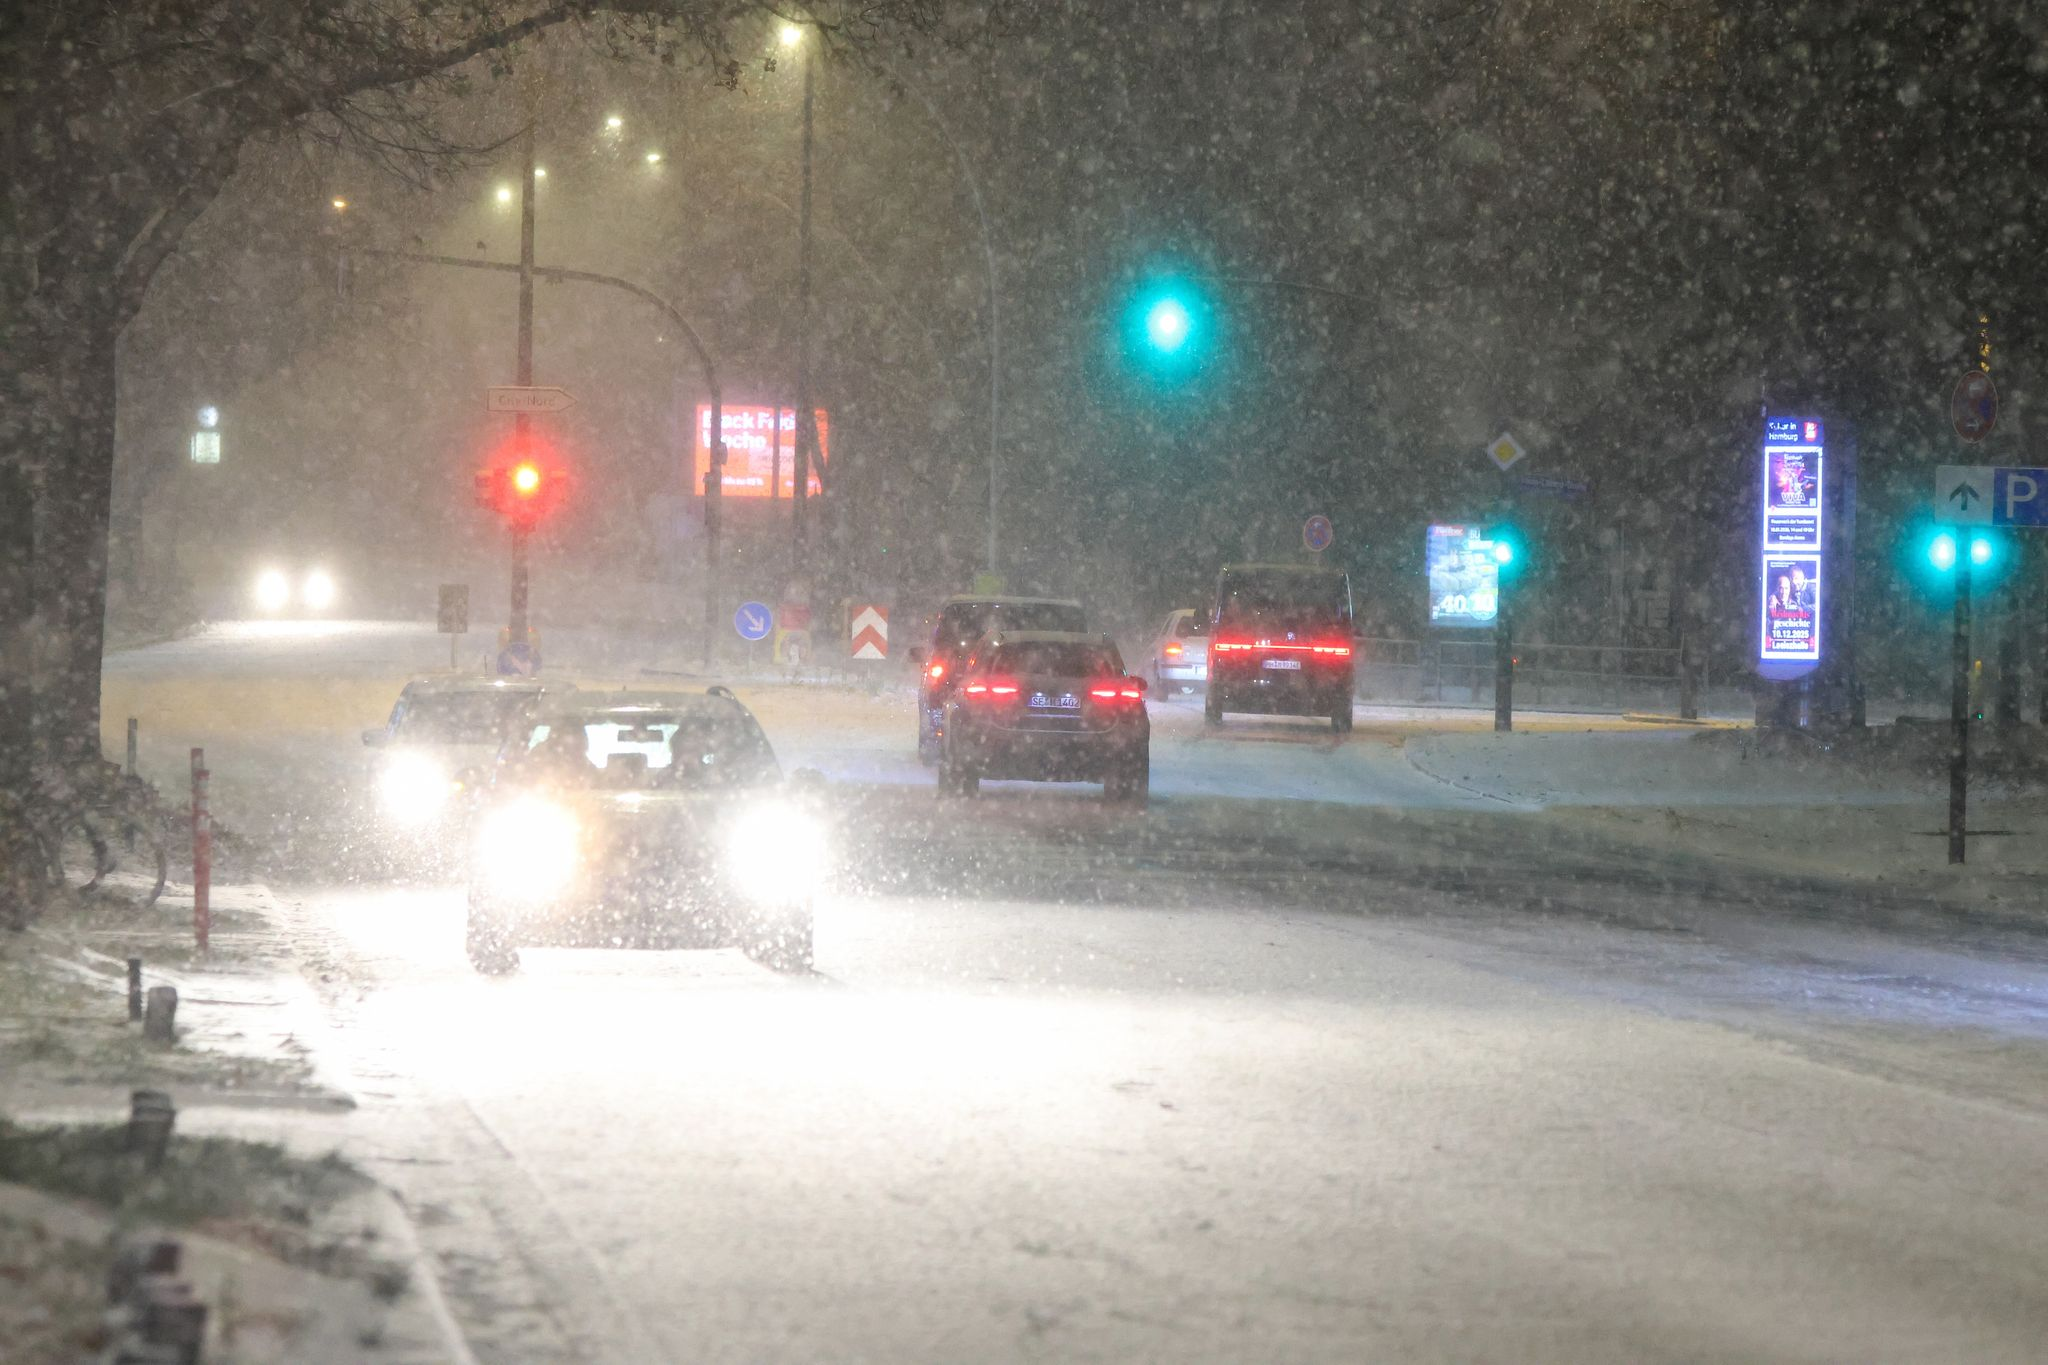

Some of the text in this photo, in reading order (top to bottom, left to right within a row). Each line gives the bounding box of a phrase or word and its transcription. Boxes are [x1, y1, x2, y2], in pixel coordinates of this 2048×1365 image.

[702, 410, 755, 429] Back
[1790, 422, 1797, 430] in
[702, 431, 767, 449] oche
[2006, 475, 2037, 519] P
